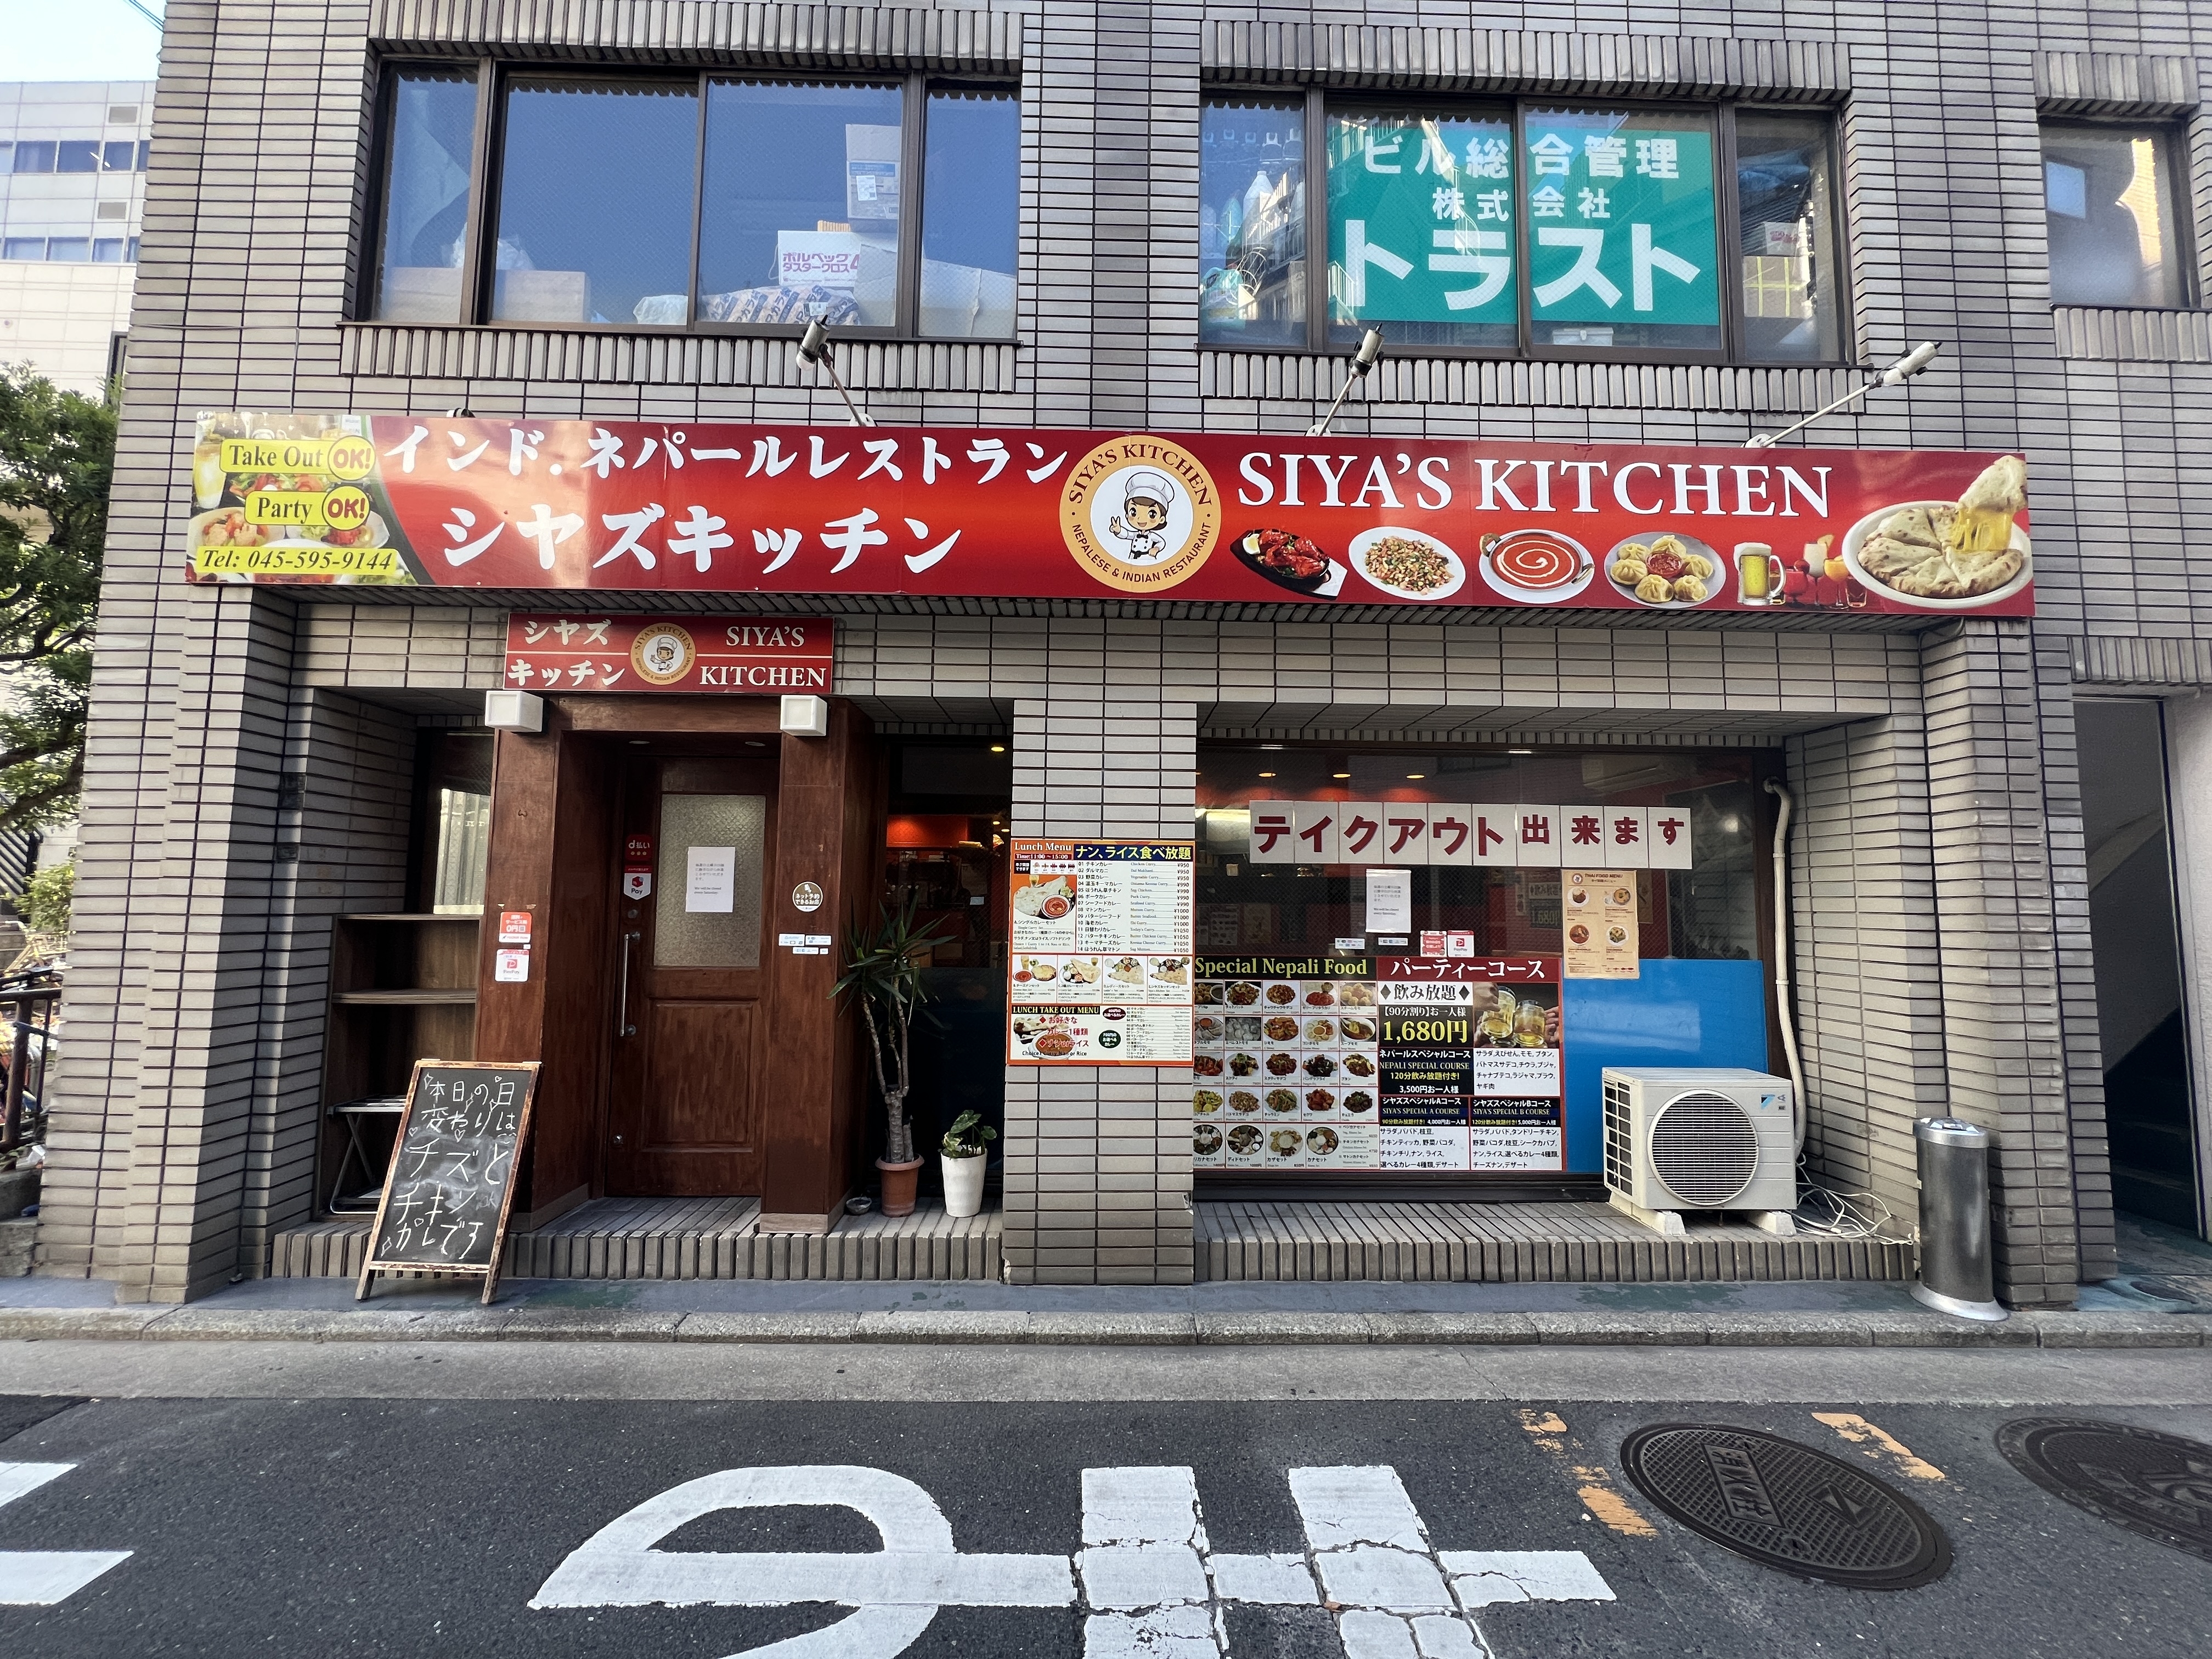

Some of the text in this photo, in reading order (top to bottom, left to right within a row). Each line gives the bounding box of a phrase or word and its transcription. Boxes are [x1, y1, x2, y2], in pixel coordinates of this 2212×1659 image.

[1365, 133, 1679, 179] ビル総合管理
[1432, 186, 1610, 221] 株式会社
[782, 263, 849, 273] ダスタークロス
[1345, 219, 1701, 311] トラスト
[229, 445, 371, 469] Take Out OK!
[1069, 444, 1212, 506] SIYA'S KITCHEN
[1238, 452, 1830, 519] SIYA'S KITCHEN
[257, 497, 365, 524] Party OK!
[442, 502, 962, 575] シヤズキッチン
[204, 550, 392, 571] Tel: 045-595-9144
[1073, 523, 1211, 582] NEPALESE & INDIAN RESTAURANT
[524, 618, 612, 646] シヤズ
[635, 626, 692, 650] SIYA'S KITCHEN
[726, 626, 804, 647] SIYA'S
[507, 659, 625, 687] キッチン
[699, 665, 826, 686] KITCHEN
[1015, 842, 1042, 850] Lunch
[1254, 814, 1685, 857] テイクアウト出来ます
[1076, 846, 1191, 860] ナン、ライス食べ放題
[1195, 958, 1367, 978] Special Nepali Food
[1391, 957, 1545, 979] パーティーコース
[1394, 984, 1456, 1001] 飲み放題
[1383, 1019, 1468, 1043] 1,680円
[1379, 1049, 1471, 1058] ネパールスペシャルコース
